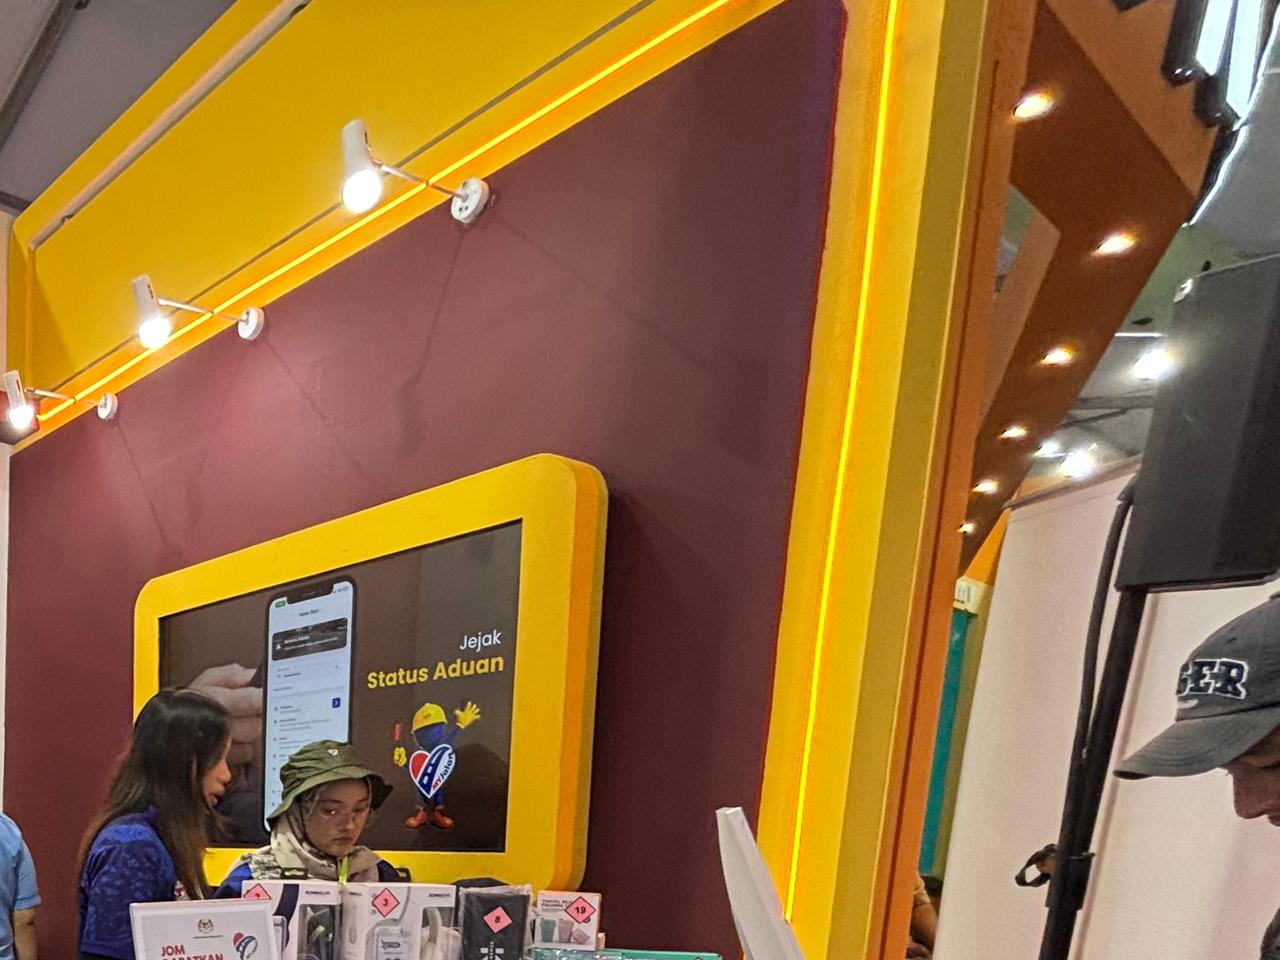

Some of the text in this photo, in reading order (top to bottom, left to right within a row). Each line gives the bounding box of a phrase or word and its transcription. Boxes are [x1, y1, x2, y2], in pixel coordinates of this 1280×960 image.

[460, 629, 502, 652] Jejak
[367, 656, 504, 689] Status Aduan
[382, 898, 389, 907] 3
[575, 906, 586, 914] 19
[160, 944, 186, 957] JOM
